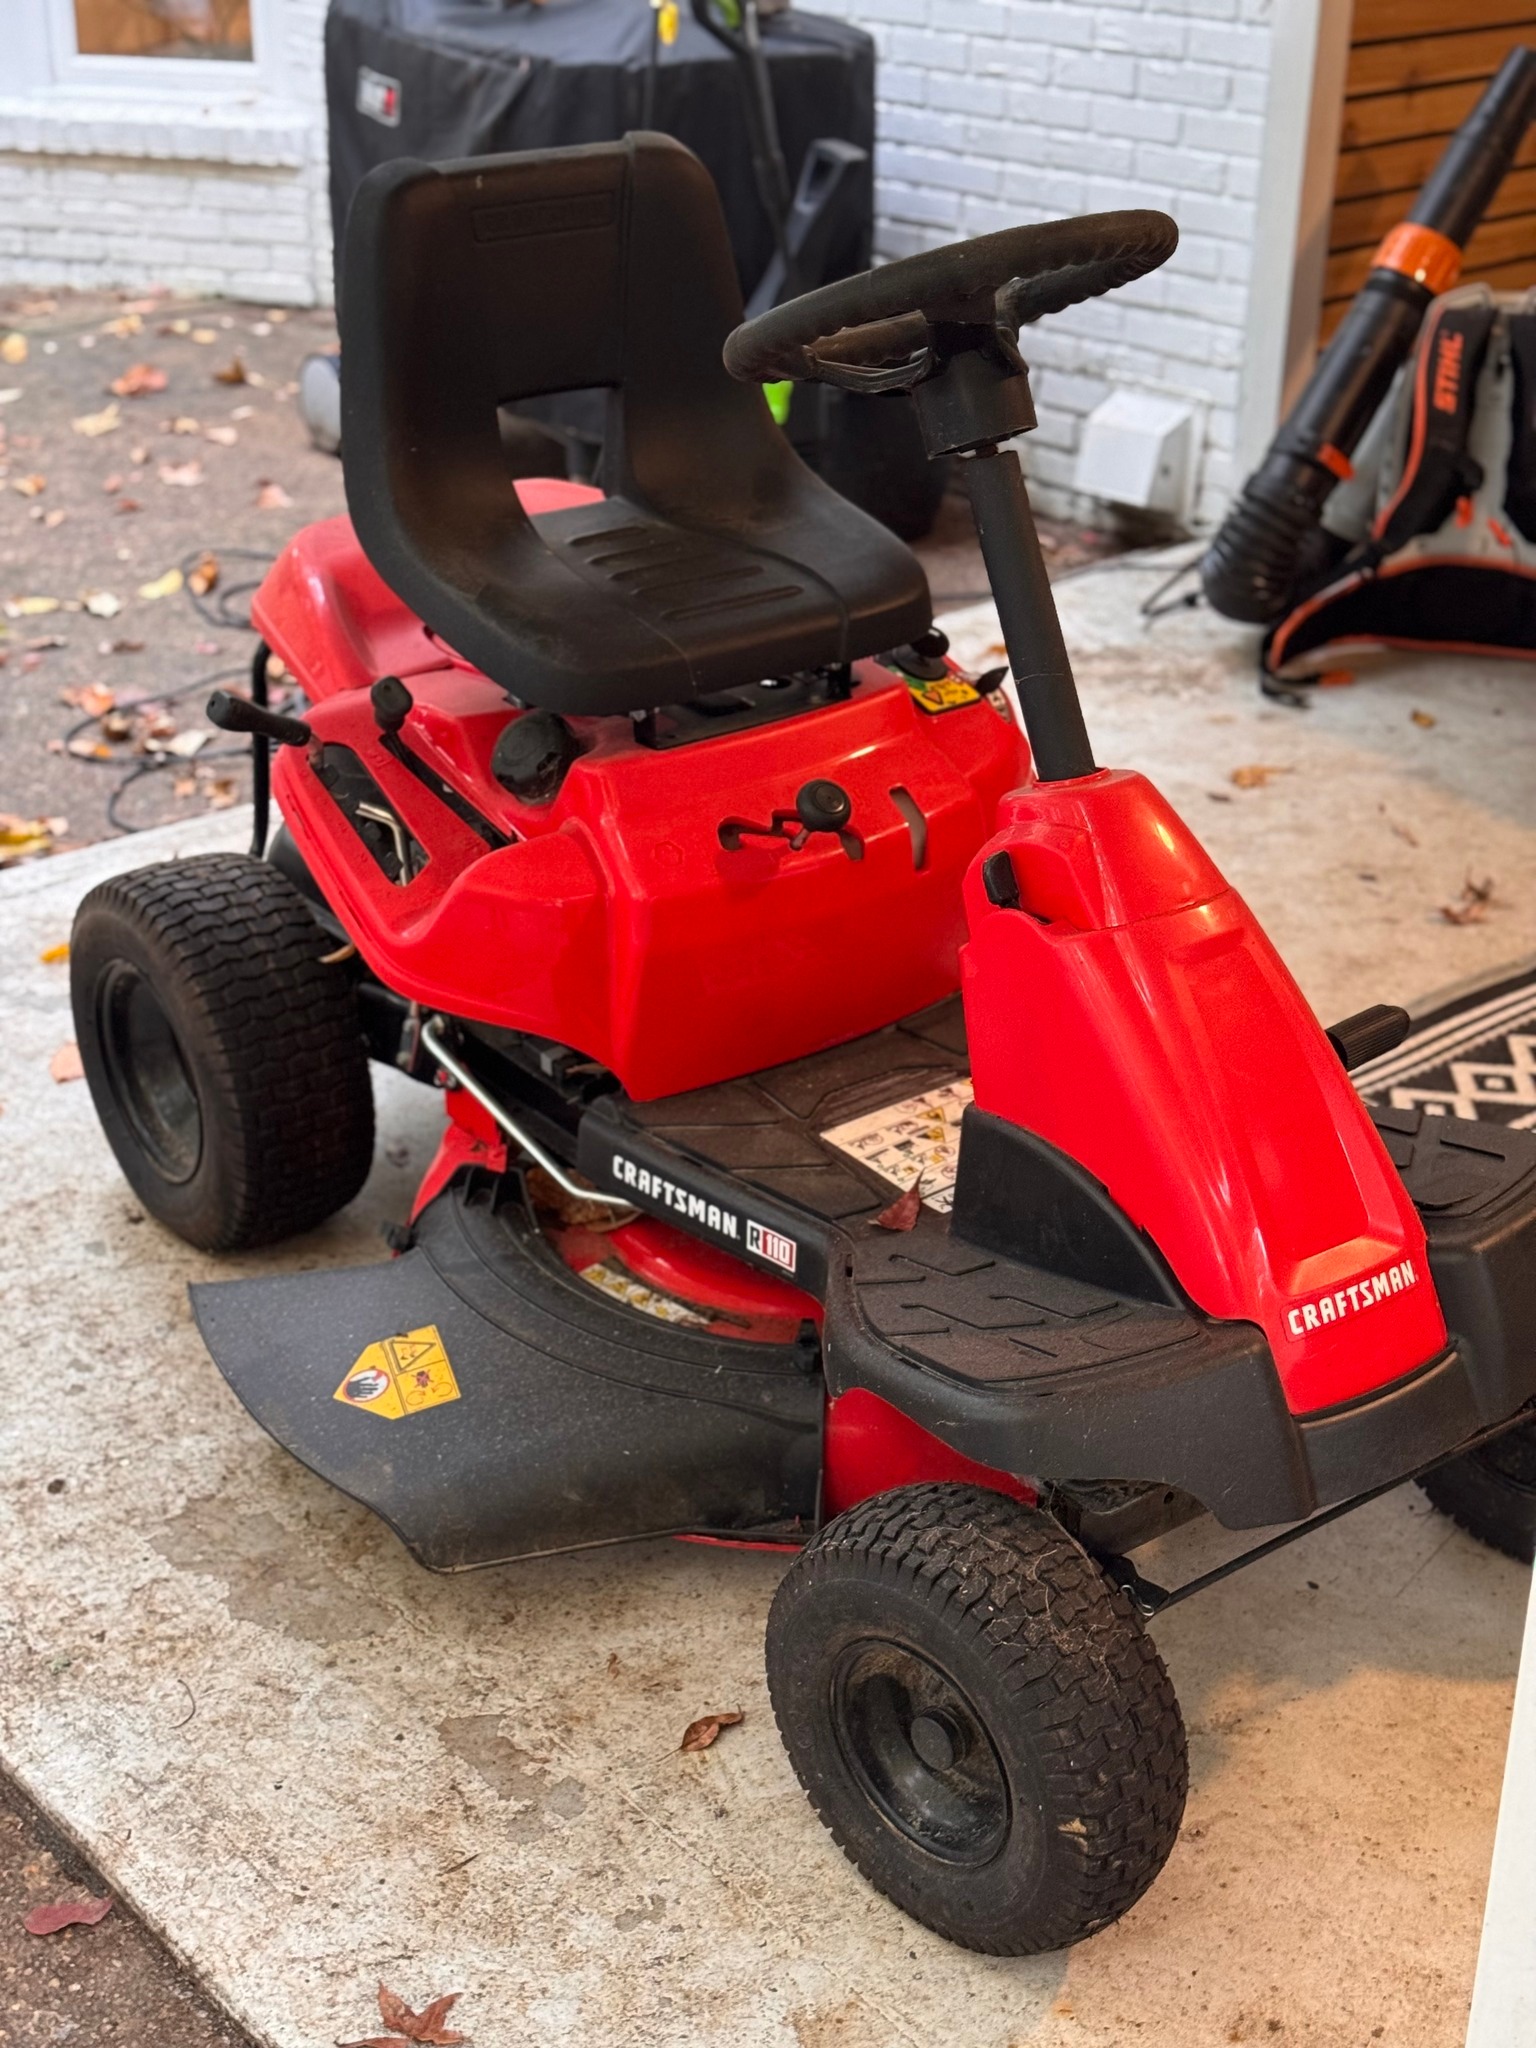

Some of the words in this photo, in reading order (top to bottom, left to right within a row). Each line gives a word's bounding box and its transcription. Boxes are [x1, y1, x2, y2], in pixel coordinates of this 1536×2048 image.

[1433, 332, 1464, 414] STIHL
[612, 1154, 738, 1240] CRAFTSMAN
[748, 1221, 796, 1271] R110
[1287, 1259, 1416, 1336] CRAFTSMAN
